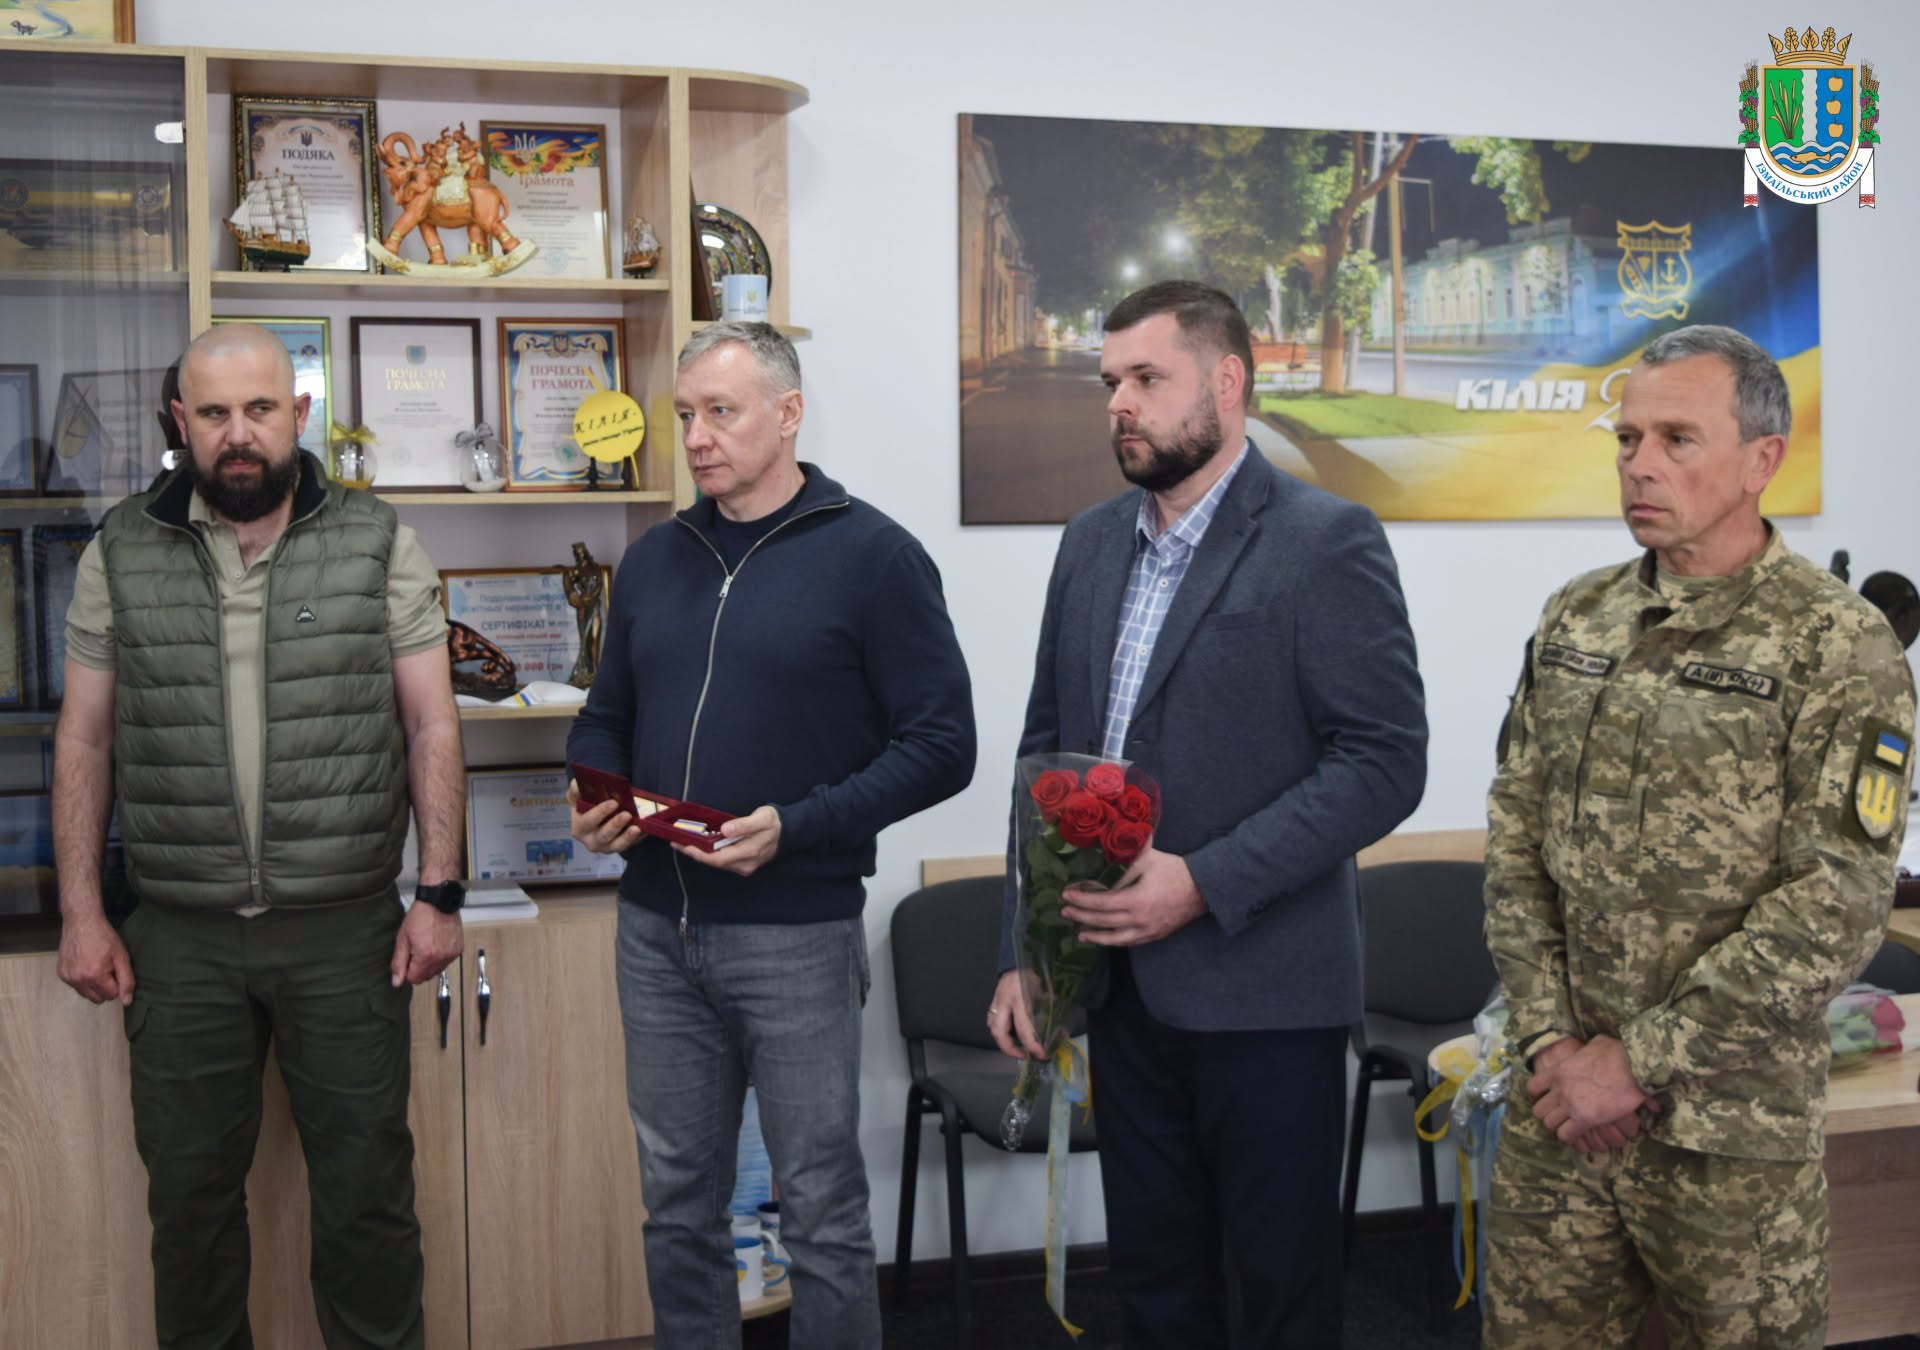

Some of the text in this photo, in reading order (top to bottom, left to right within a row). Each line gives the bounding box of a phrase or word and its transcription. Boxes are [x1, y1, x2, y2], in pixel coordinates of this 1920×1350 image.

[281, 148, 335, 162] ПОДЯКА
[532, 379, 596, 390] ГРАМОТА
[1455, 378, 1586, 411] КІЛІЯ
[481, 619, 545, 631] СЕРТИФІКАТ
